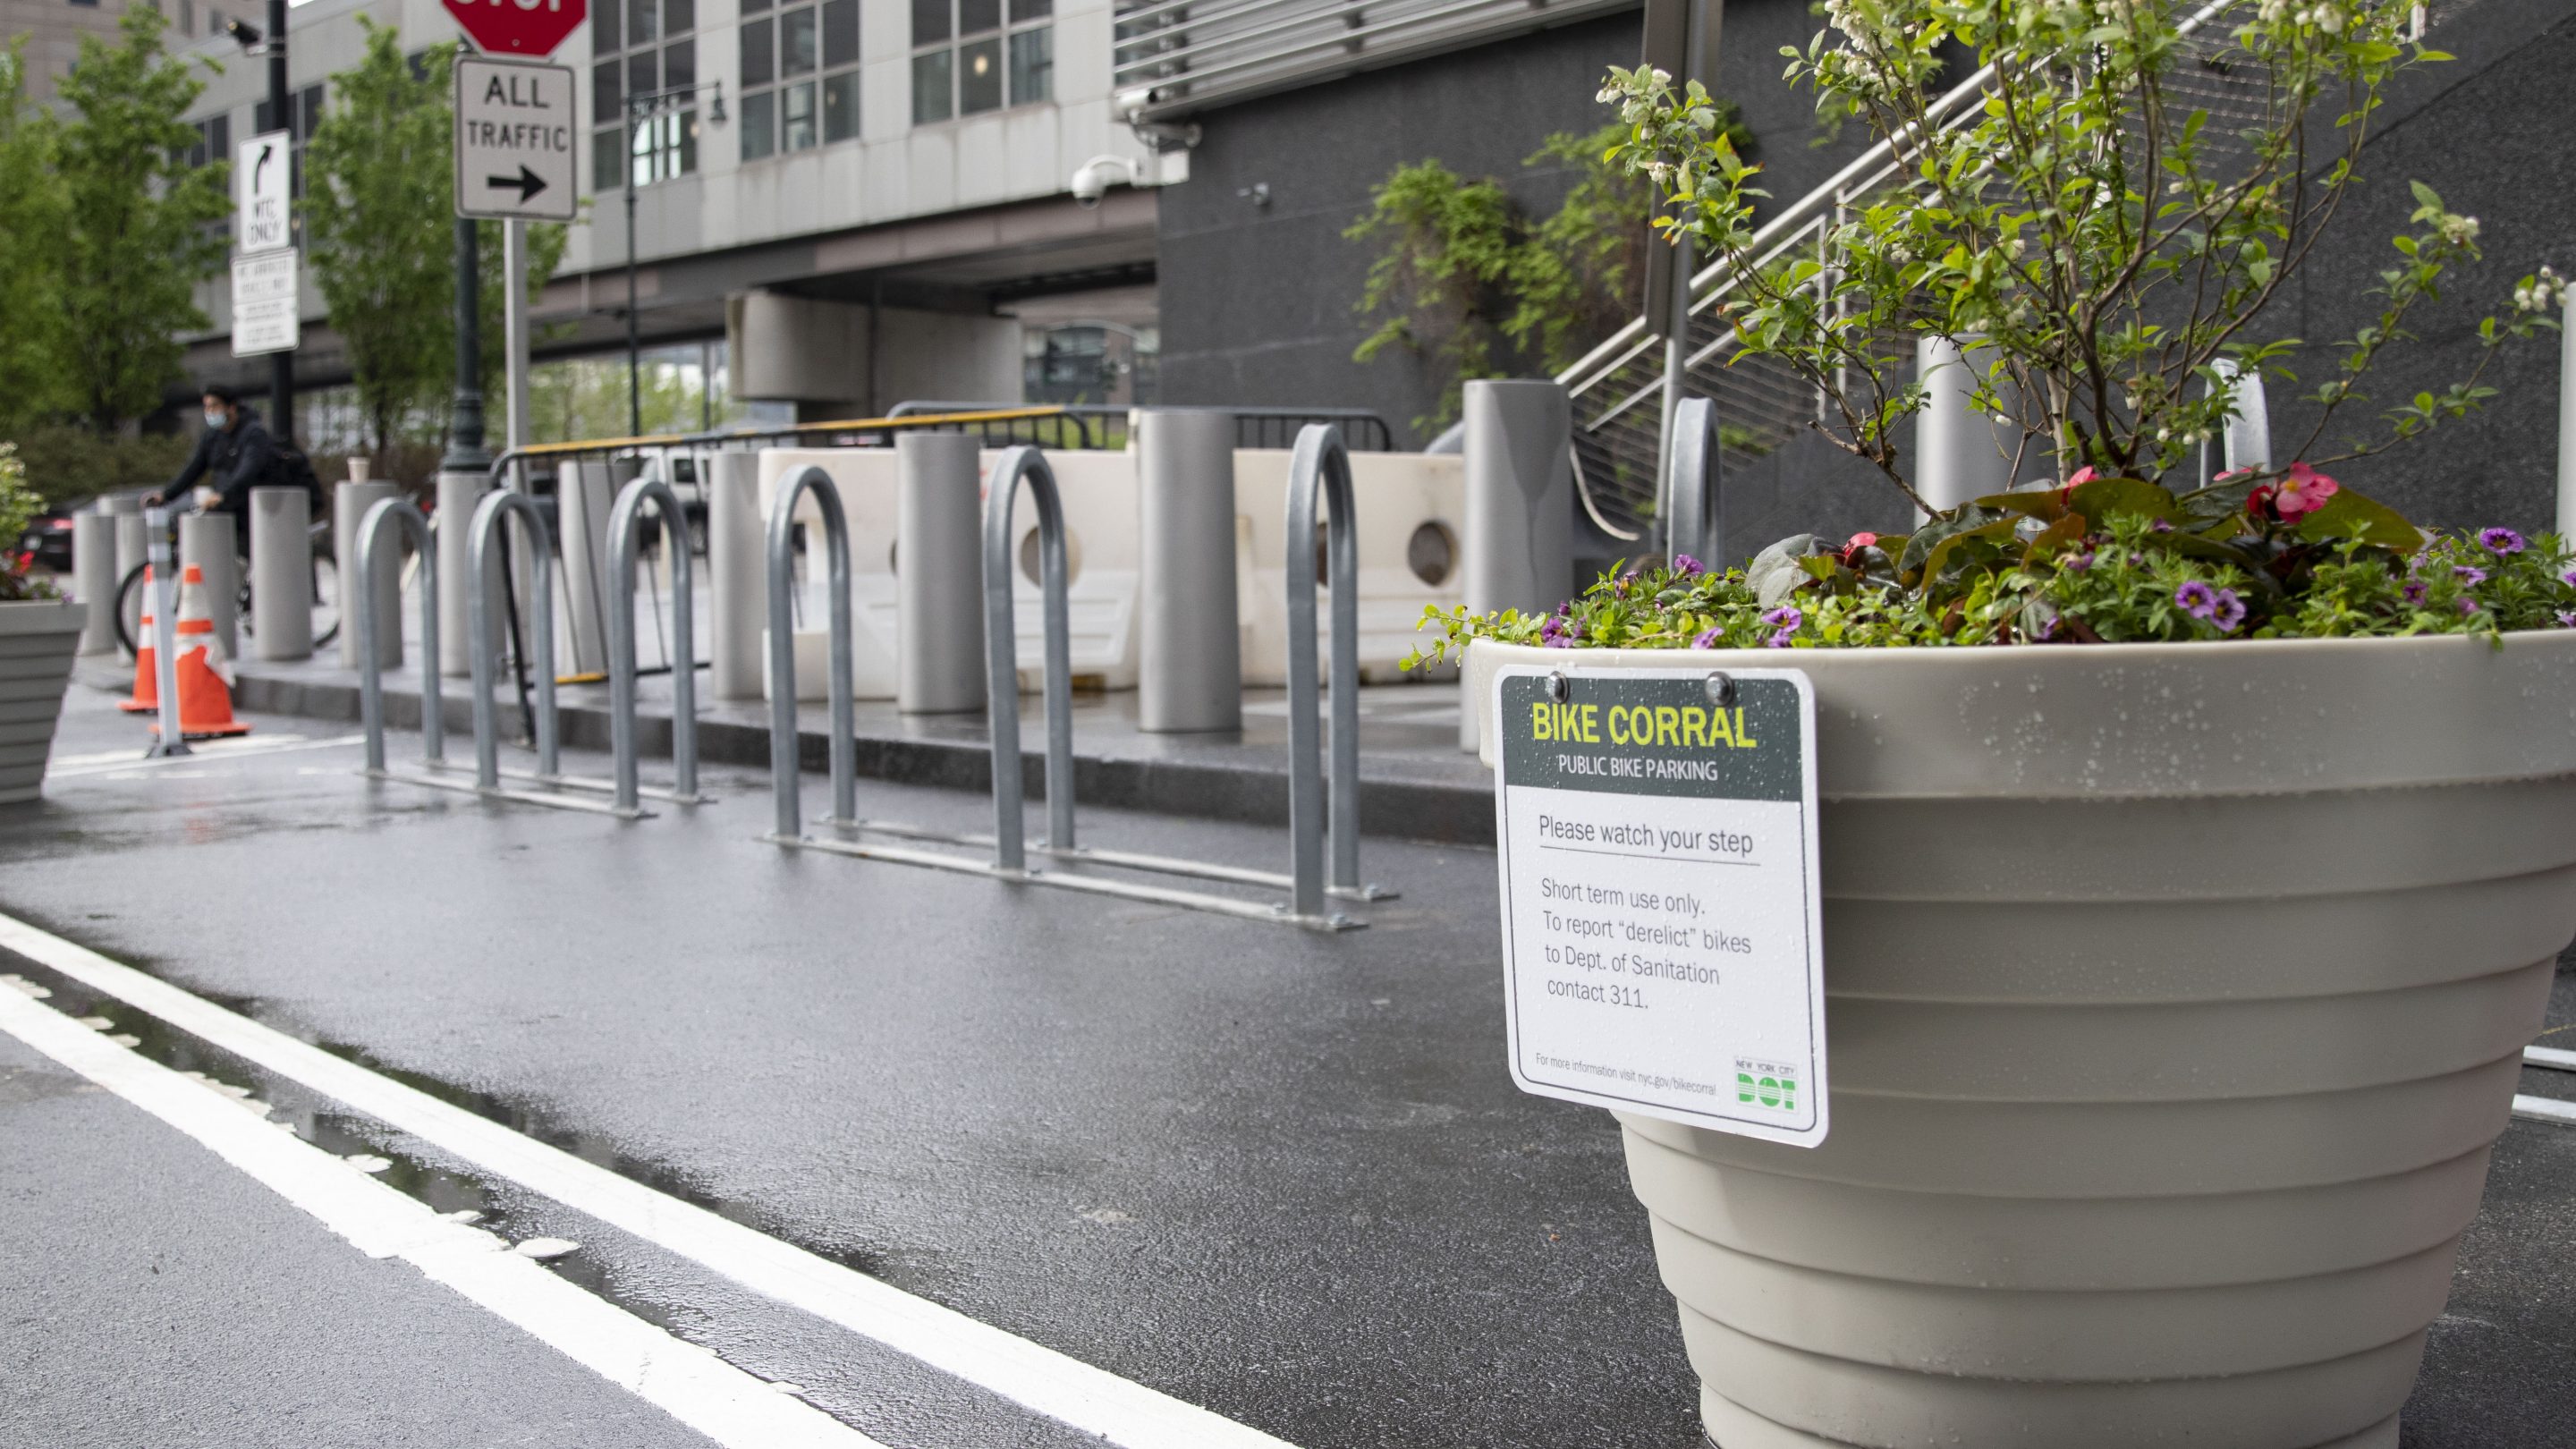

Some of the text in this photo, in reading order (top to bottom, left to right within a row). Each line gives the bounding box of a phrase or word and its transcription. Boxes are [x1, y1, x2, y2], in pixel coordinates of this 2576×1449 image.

[485, 74, 550, 109] ALL
[466, 120, 568, 152] TRAFFIC
[246, 218, 283, 245] ONLY
[1532, 702, 1758, 748] BIKE CORRAL
[1558, 754, 1718, 781] PUBLIC BIKE PARKING
[1539, 815, 1753, 857] Please watch your step
[1541, 877, 1706, 919] Short term use only.
[1543, 911, 1751, 953] To report “derelict” bikes
[1545, 945, 1720, 985] to Dept. of Sanitation
[1547, 980, 1648, 1009] contact 311.
[1536, 1053, 1548, 1065] For
[1550, 1058, 1570, 1070] more
[1572, 1060, 1617, 1079] information
[1619, 1069, 1636, 1081] visit
[1736, 1060, 1794, 1074] NEW YORK CITY
[1738, 1073, 1796, 1110] DOT
